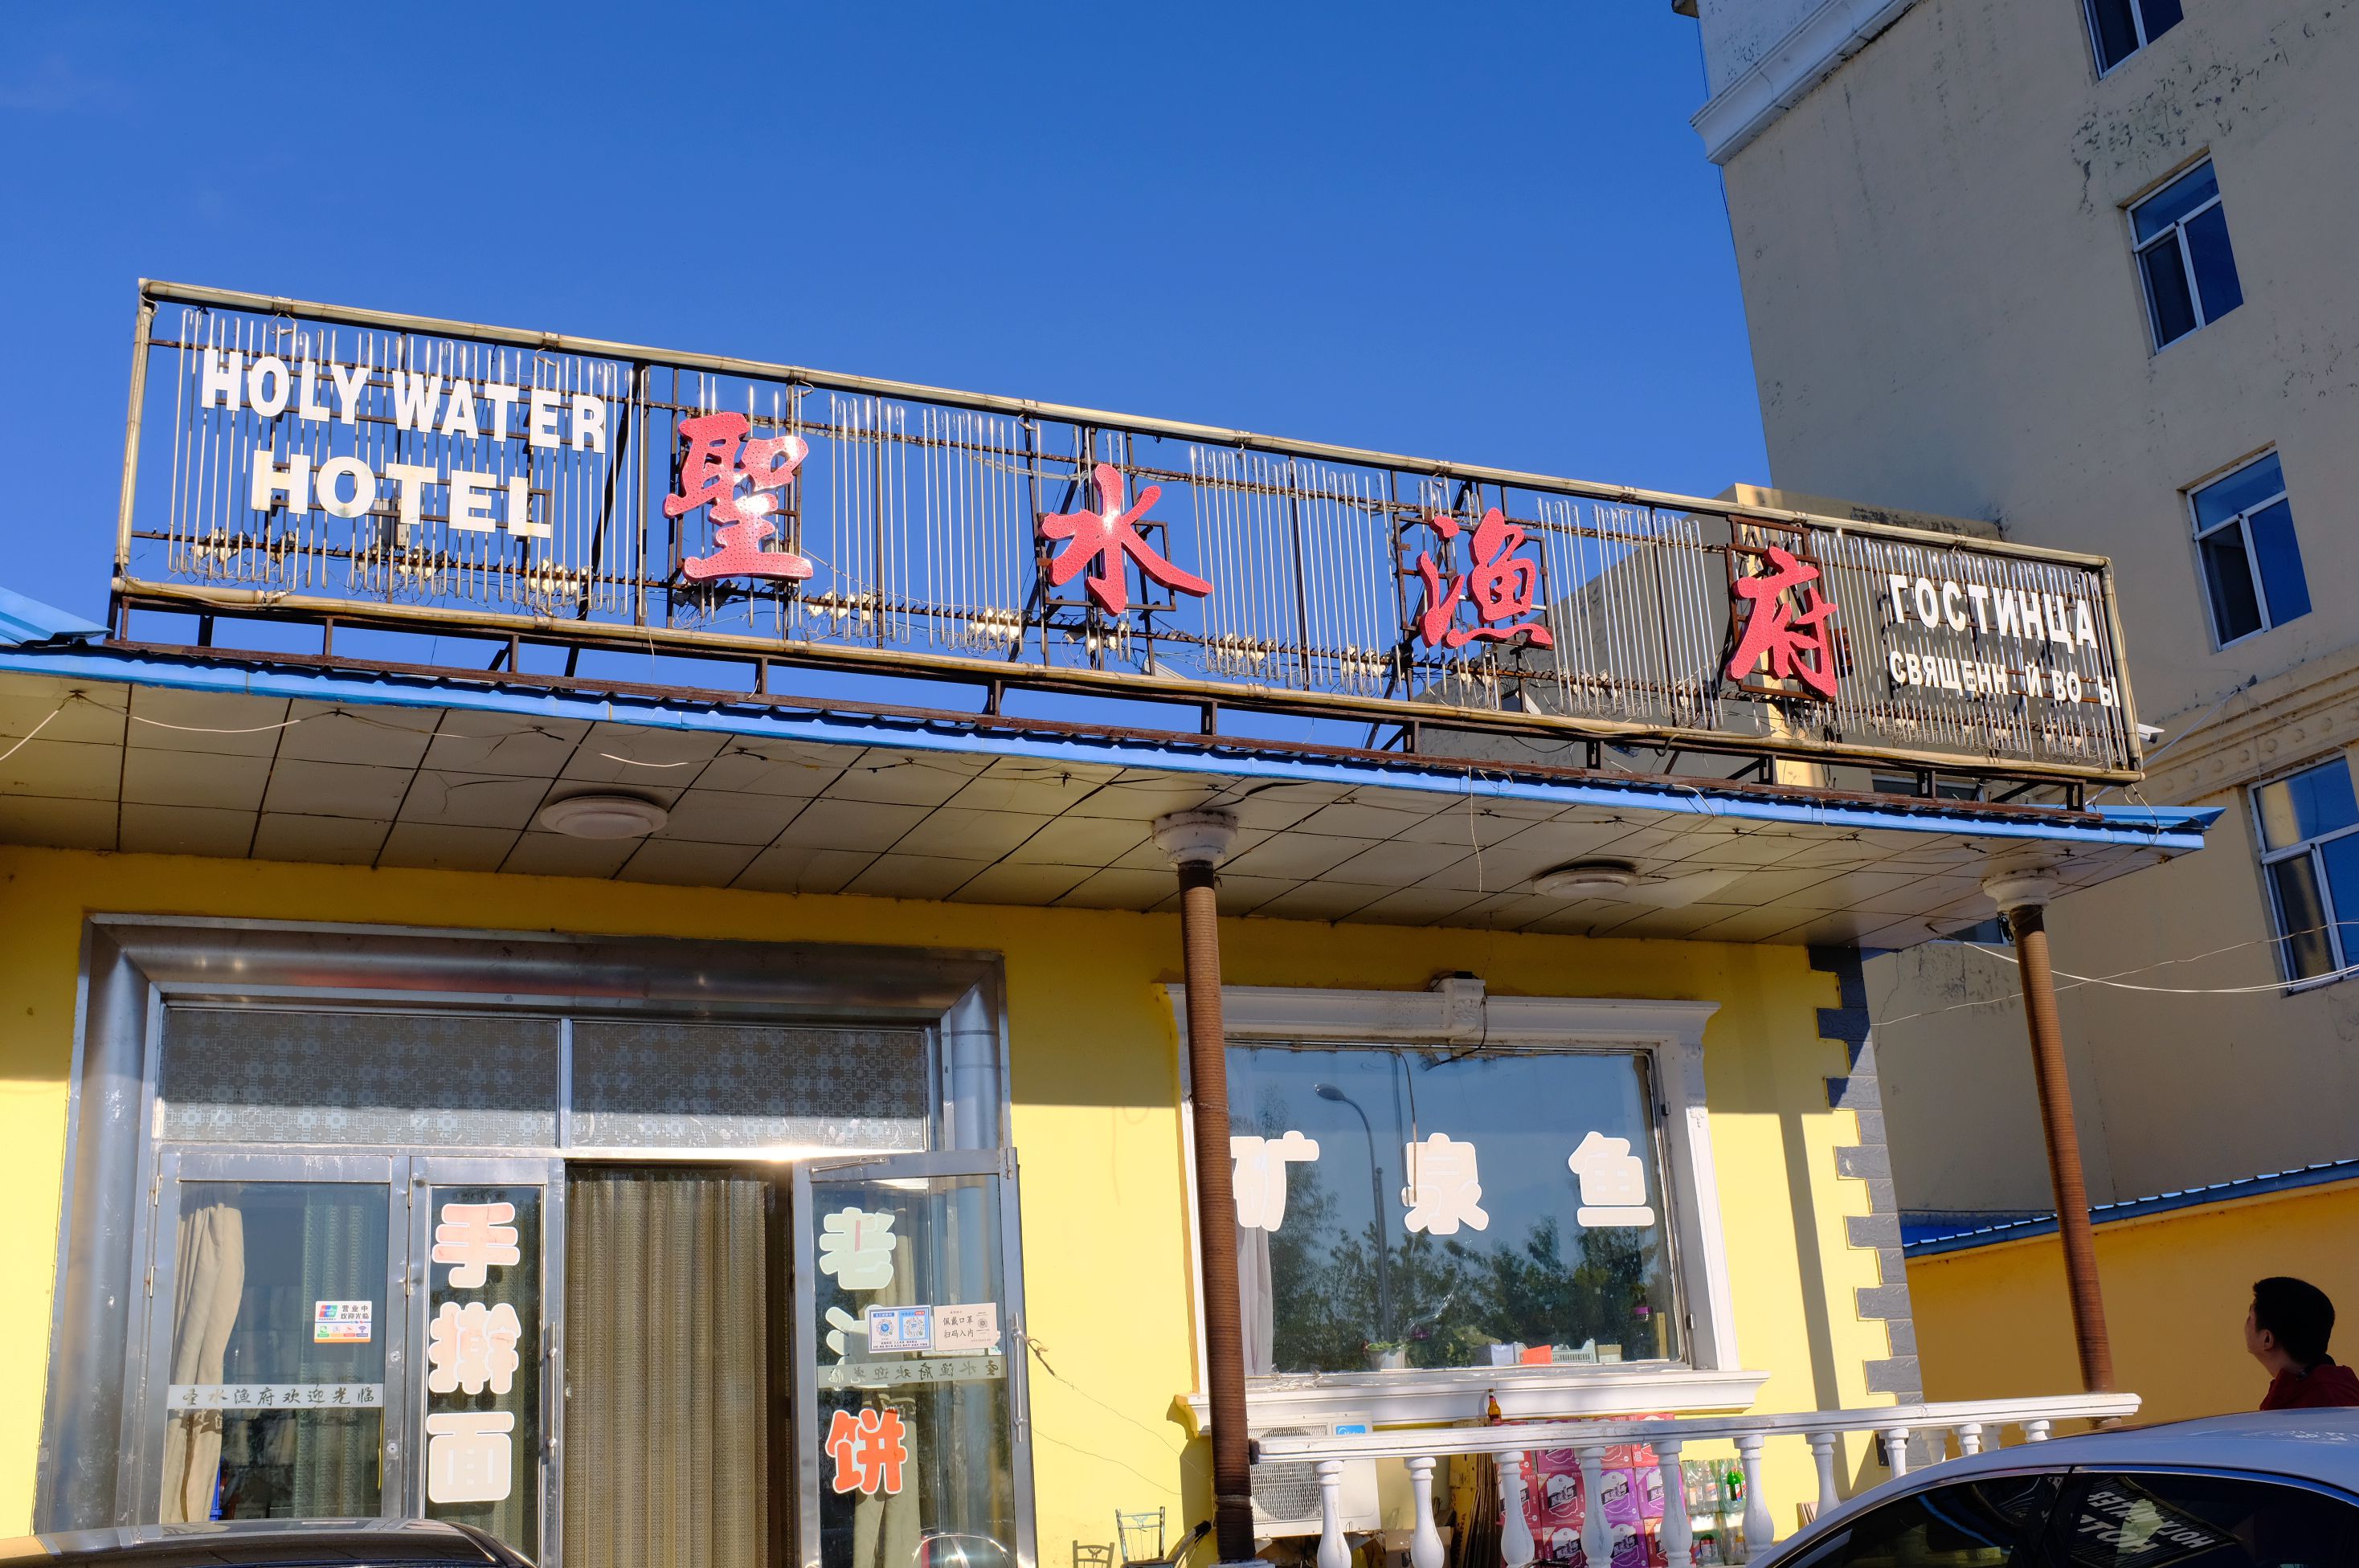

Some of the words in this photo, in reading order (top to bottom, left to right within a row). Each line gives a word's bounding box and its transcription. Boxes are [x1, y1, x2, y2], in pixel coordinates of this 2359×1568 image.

[201, 349, 370, 426] HOLY
[393, 370, 606, 455] WATER
[251, 450, 551, 539] HOTEL
[1889, 574, 2098, 654] ГОСТИНЦА
[943, 1328, 975, 1339] 扫码入内
